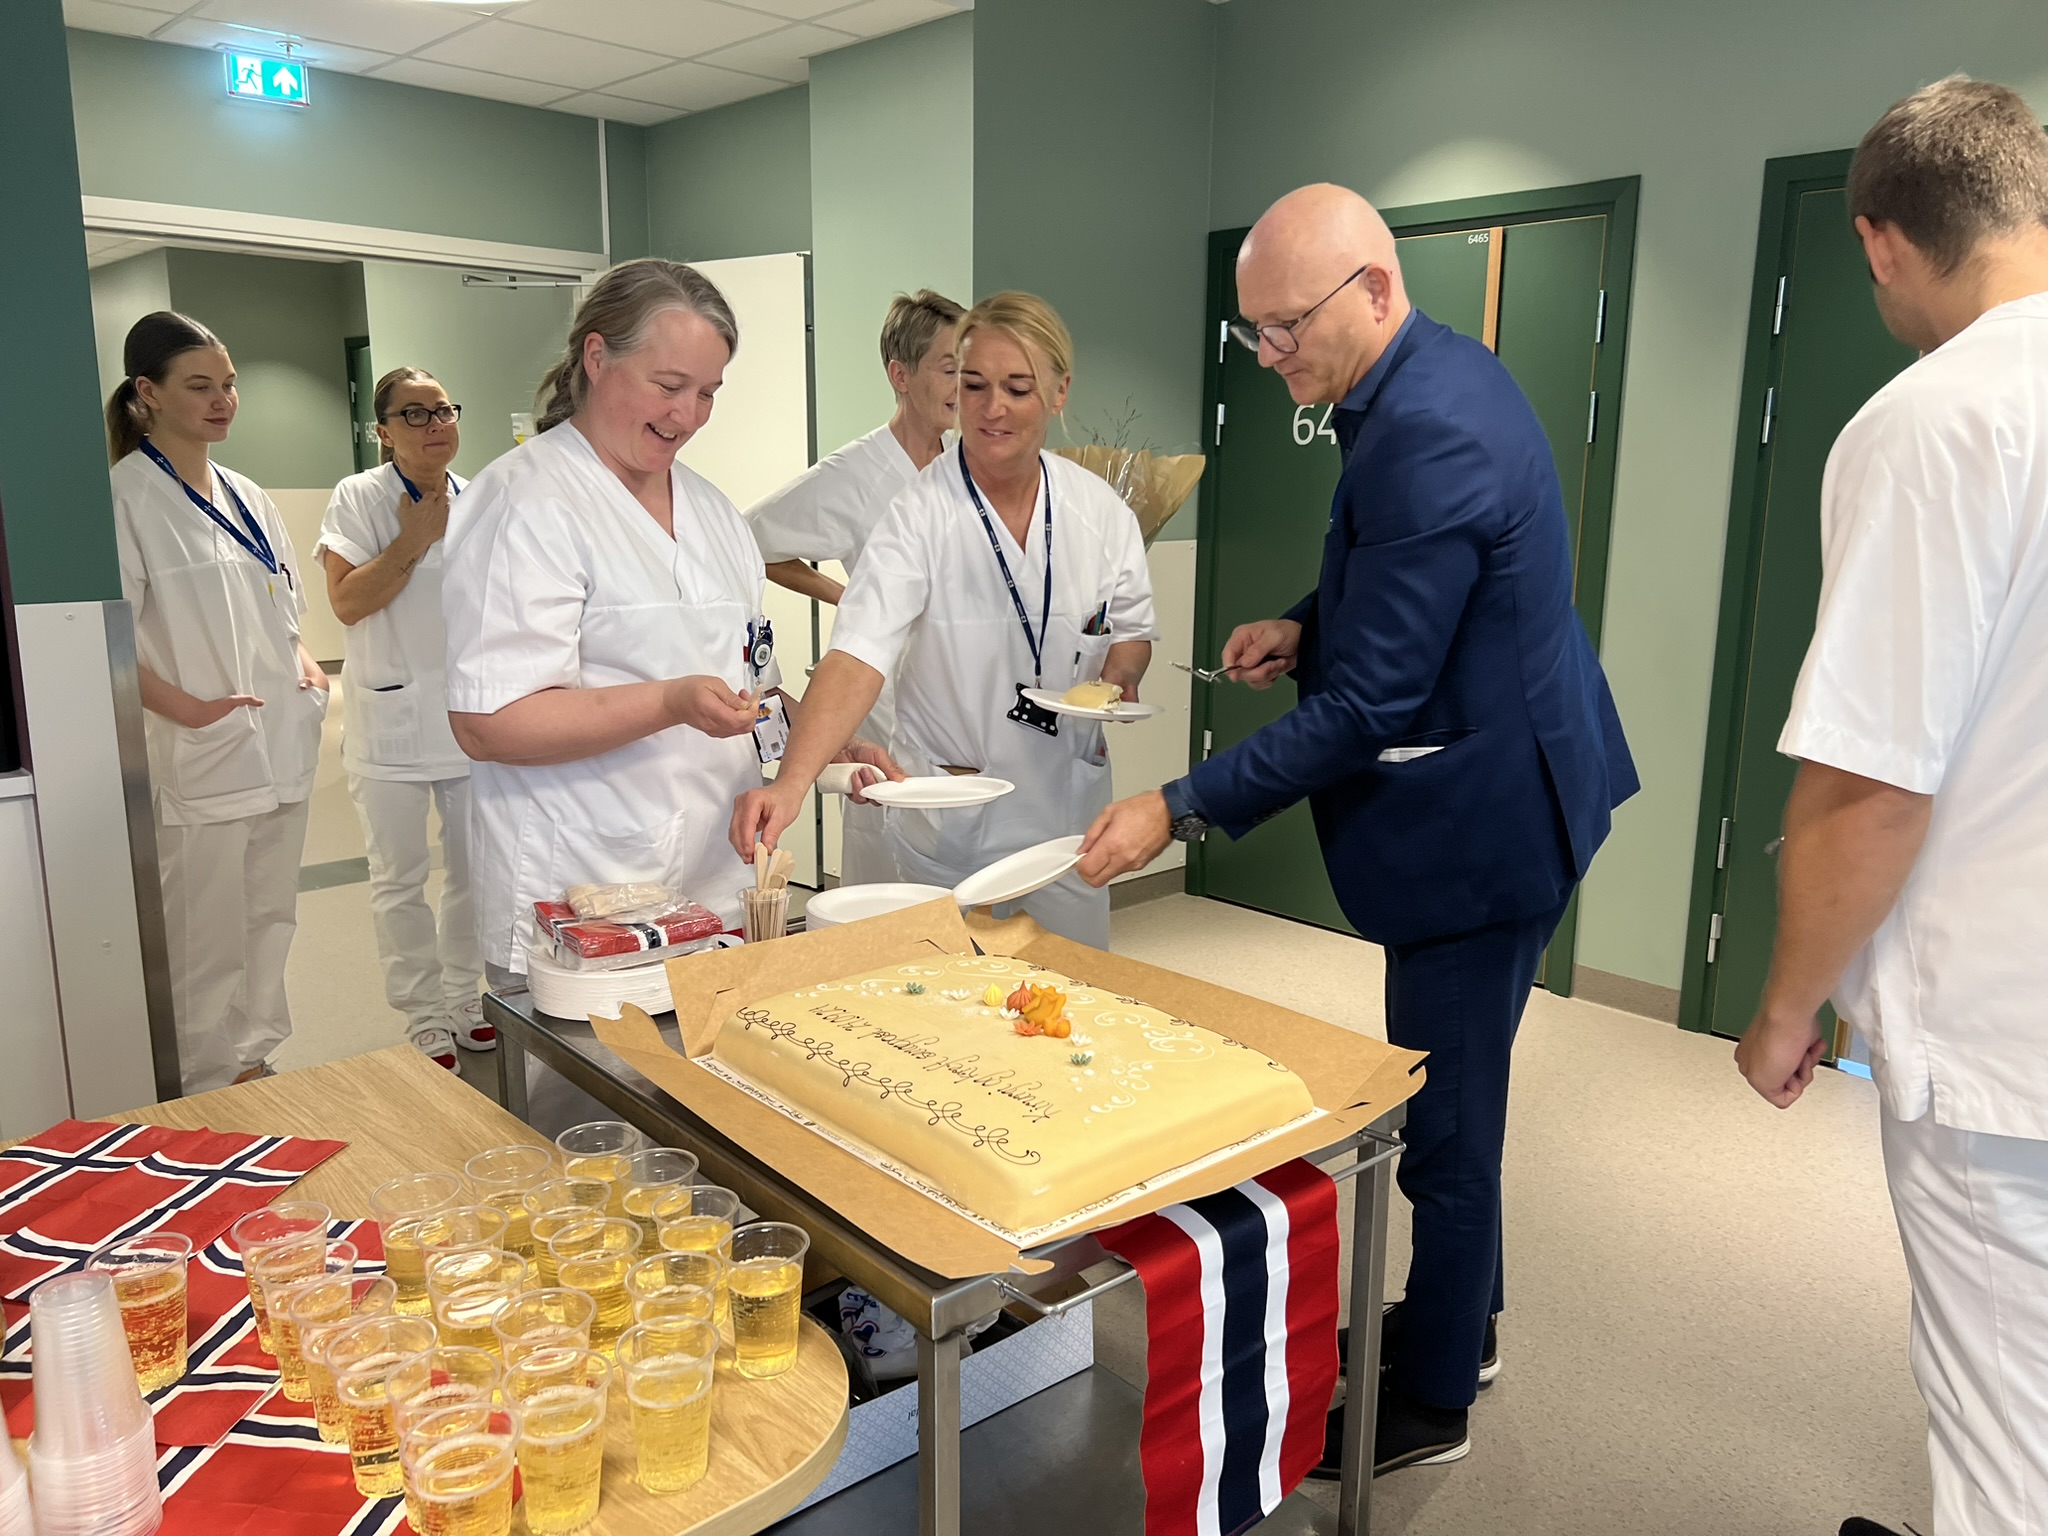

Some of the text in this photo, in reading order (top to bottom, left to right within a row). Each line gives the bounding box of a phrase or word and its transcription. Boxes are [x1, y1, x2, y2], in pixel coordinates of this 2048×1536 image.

[1467, 232, 1489, 244] 6465
[808, 1003, 873, 1032] 24.09.24
[922, 1055, 980, 1084] kreft
[974, 1069, 1016, 1087] og
[987, 1081, 1062, 1123] Kirurgi
